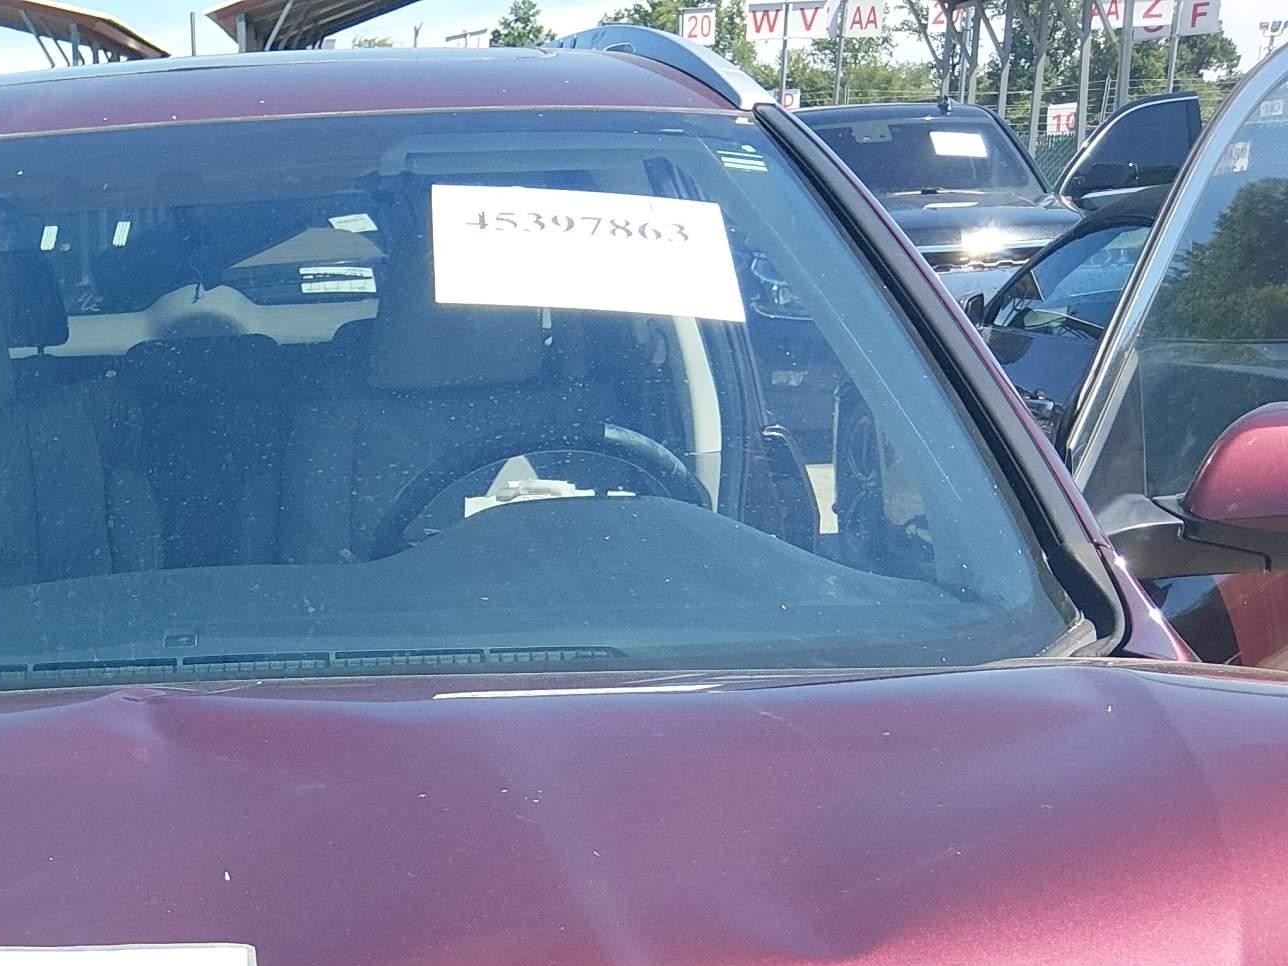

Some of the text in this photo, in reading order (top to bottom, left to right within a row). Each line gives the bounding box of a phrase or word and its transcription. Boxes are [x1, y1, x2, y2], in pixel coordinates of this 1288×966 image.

[687, 15, 711, 38] 20
[752, 9, 780, 33] W
[800, 7, 820, 31] V
[849, 6, 878, 30] AA
[1191, 2, 1210, 28] F
[465, 211, 690, 242] 45397863
